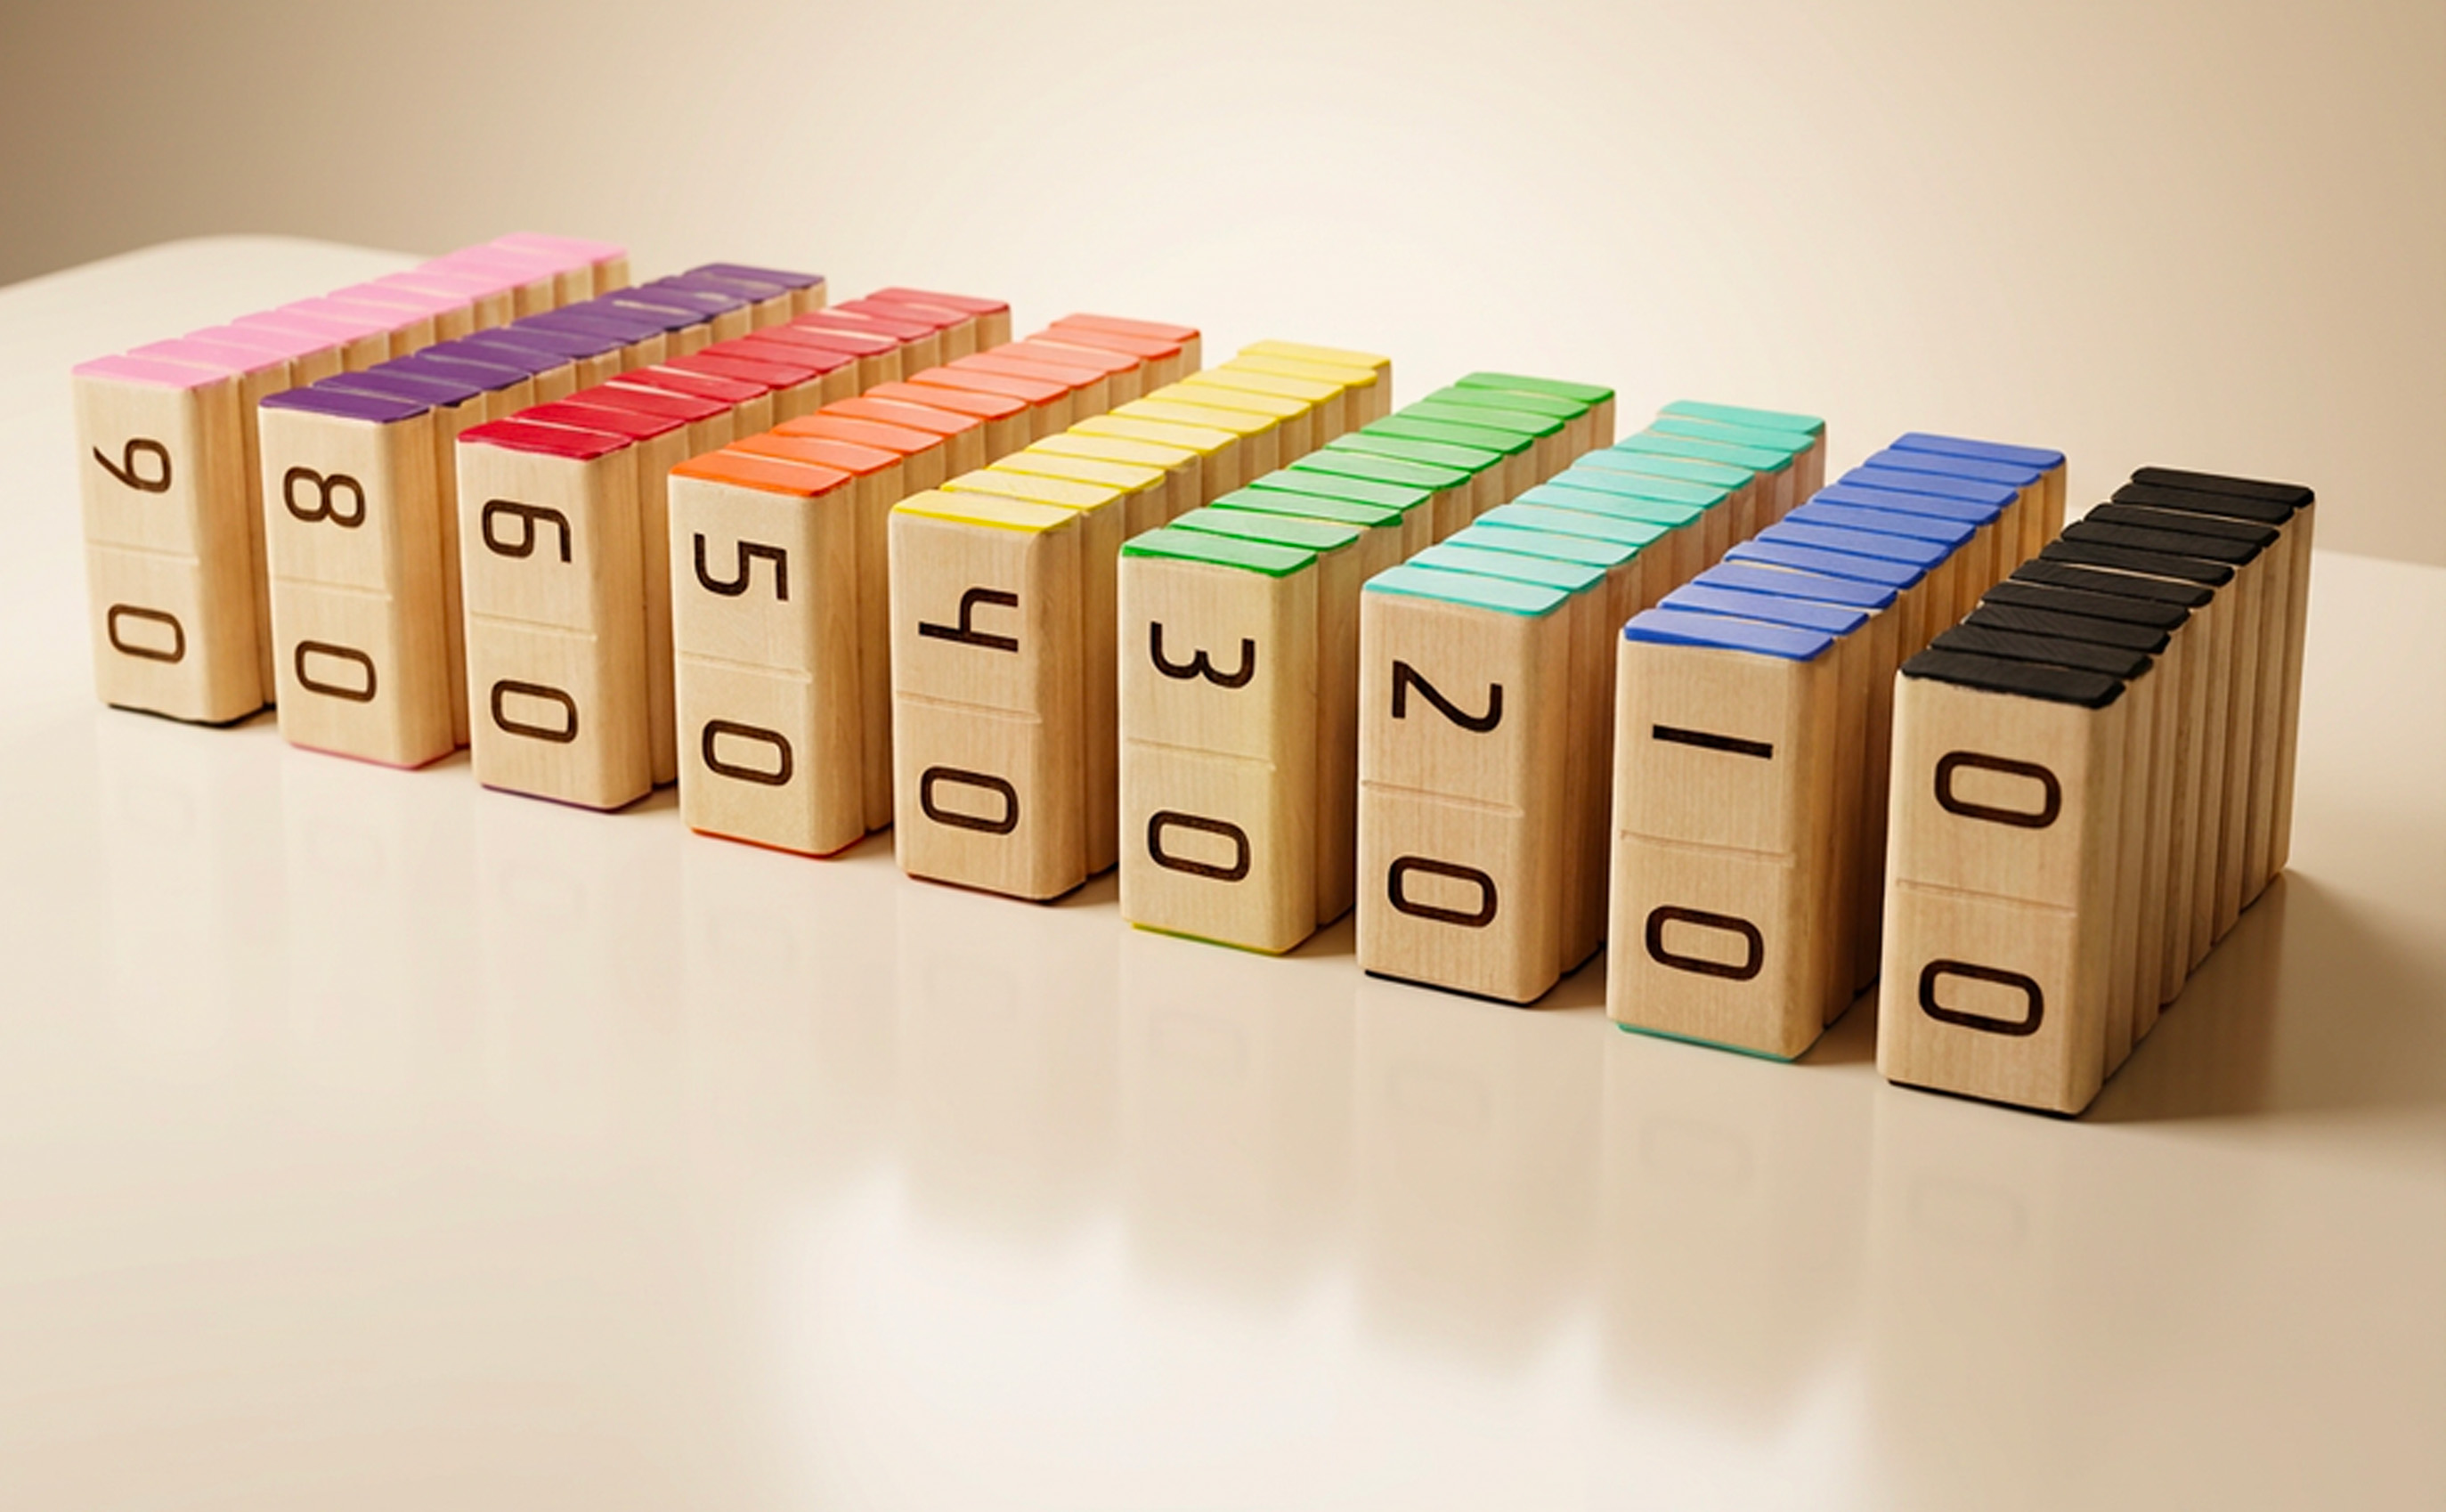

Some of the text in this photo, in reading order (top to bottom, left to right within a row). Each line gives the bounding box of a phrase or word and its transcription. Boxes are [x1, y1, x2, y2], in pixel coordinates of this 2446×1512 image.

[93, 438, 185, 663] 9 0
[283, 467, 377, 703] 8 0
[481, 499, 579, 744] 6 0
[693, 532, 793, 787] 5 0
[917, 587, 1020, 836] 4 0
[1147, 620, 1256, 882] 3 0
[1386, 659, 1504, 929] 2 0
[1645, 905, 1765, 982] 0
[1917, 750, 2063, 1037] 0 0
